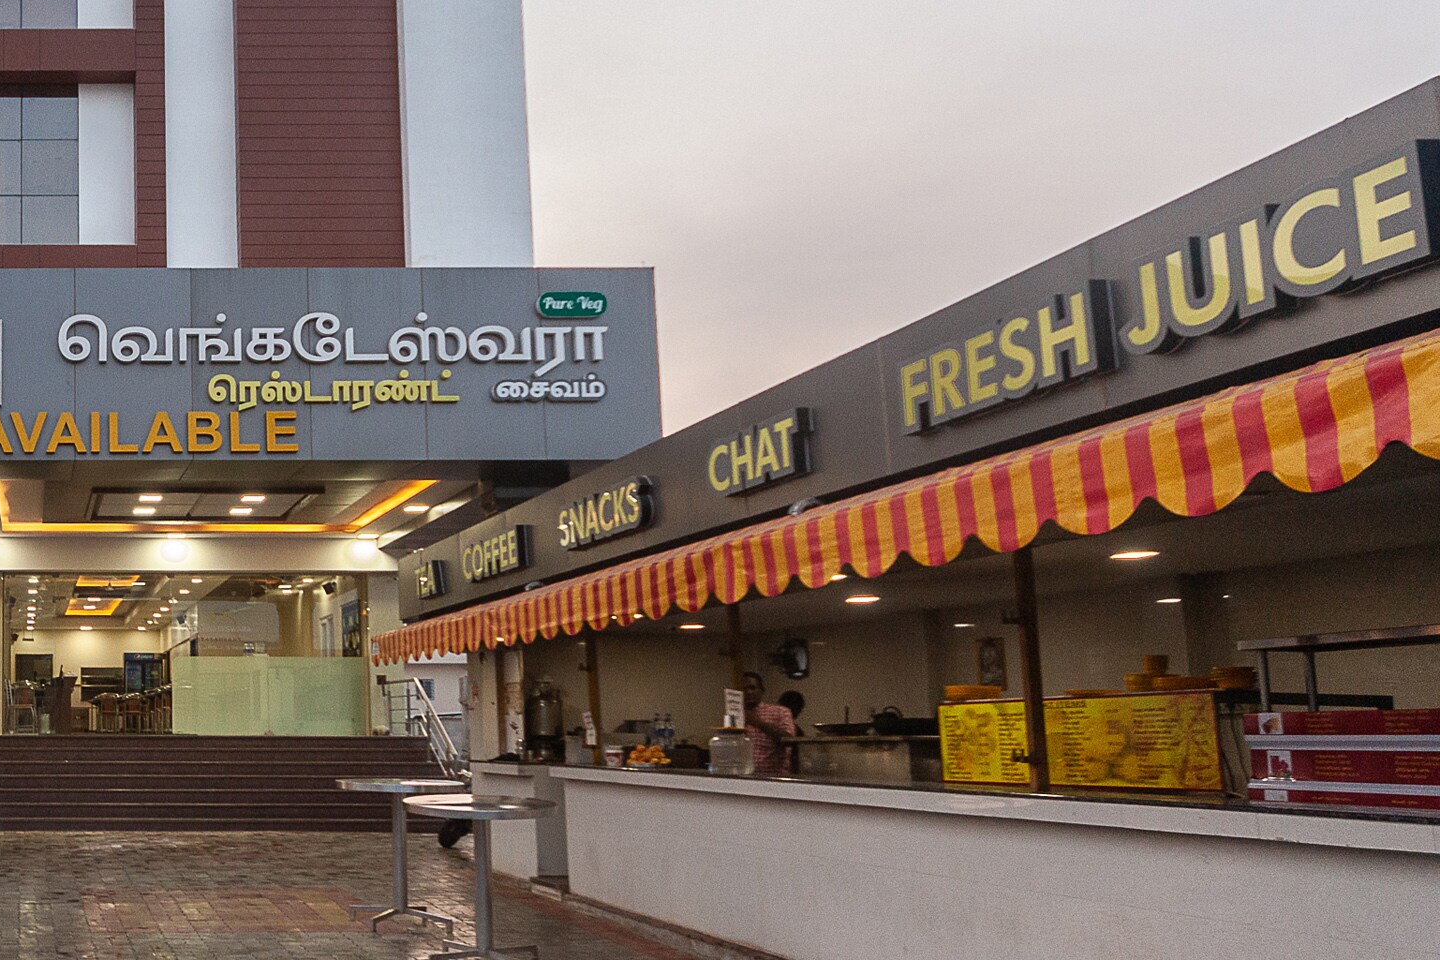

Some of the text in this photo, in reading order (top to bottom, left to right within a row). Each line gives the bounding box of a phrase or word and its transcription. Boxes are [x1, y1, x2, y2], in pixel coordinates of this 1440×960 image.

[542, 295, 604, 313] Pure Veg
[900, 156, 1418, 427] FRESH JUICE
[58, 310, 609, 377] வெங்கடேஸ்வரா
[207, 370, 460, 411] ரெஸ்டாரண்ட்
[495, 374, 606, 400] சைவம்
[708, 416, 794, 492] CHAT
[559, 482, 640, 548] SNACKS
[415, 562, 437, 597] TEA
[462, 529, 518, 581] COFFEE
